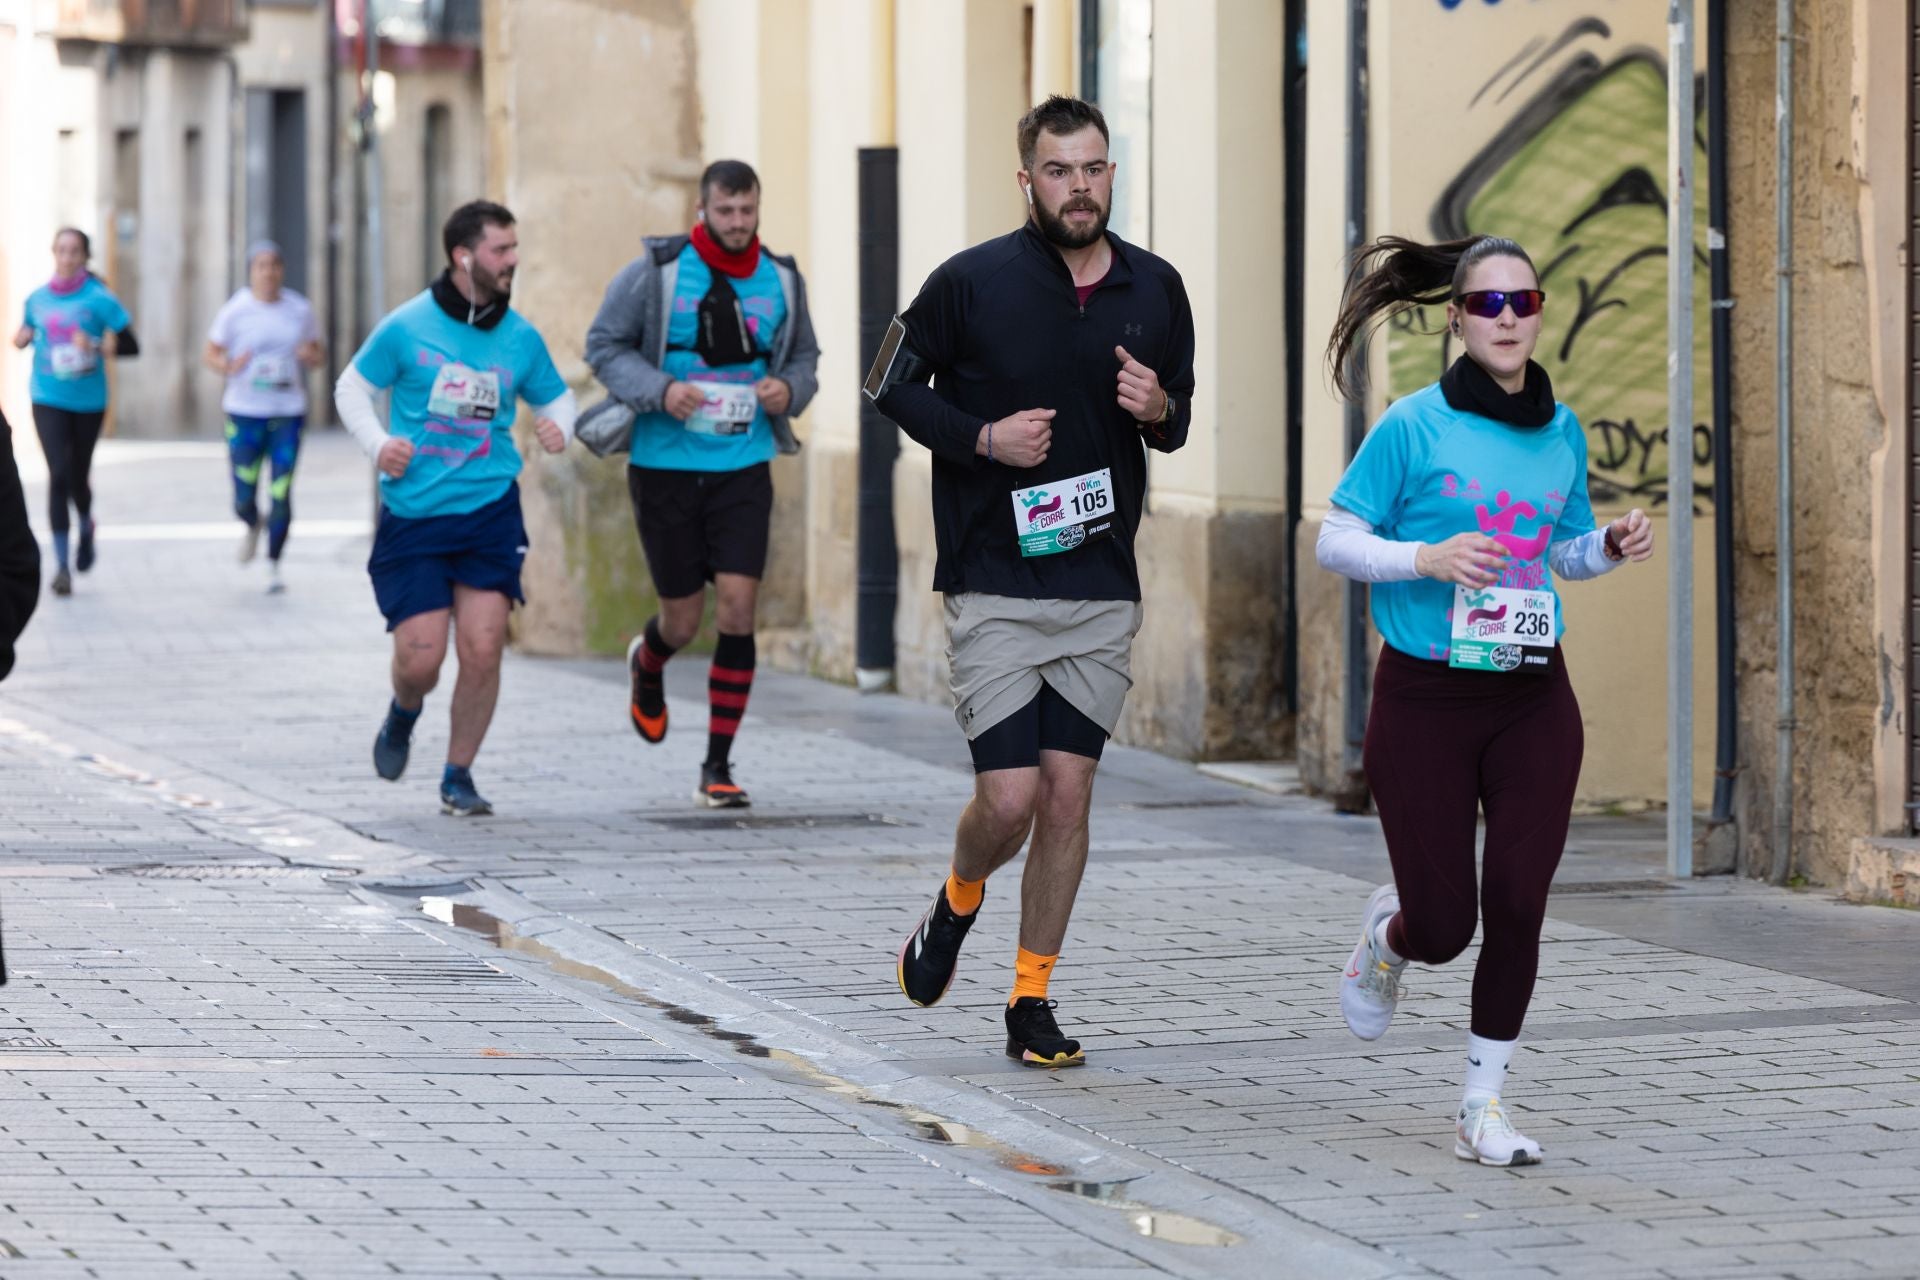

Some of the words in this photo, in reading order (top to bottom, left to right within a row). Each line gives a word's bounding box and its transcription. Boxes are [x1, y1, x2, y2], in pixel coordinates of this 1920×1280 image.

[1075, 479, 1101, 493] 10Km
[1070, 488, 1108, 516] 105
[1029, 520, 1041, 534] SE
[1040, 508, 1066, 529] CORRE
[1523, 597, 1546, 609] 10Km
[1465, 625, 1477, 639] SE
[1478, 620, 1508, 637] CORRE
[1513, 611, 1549, 637] 236
